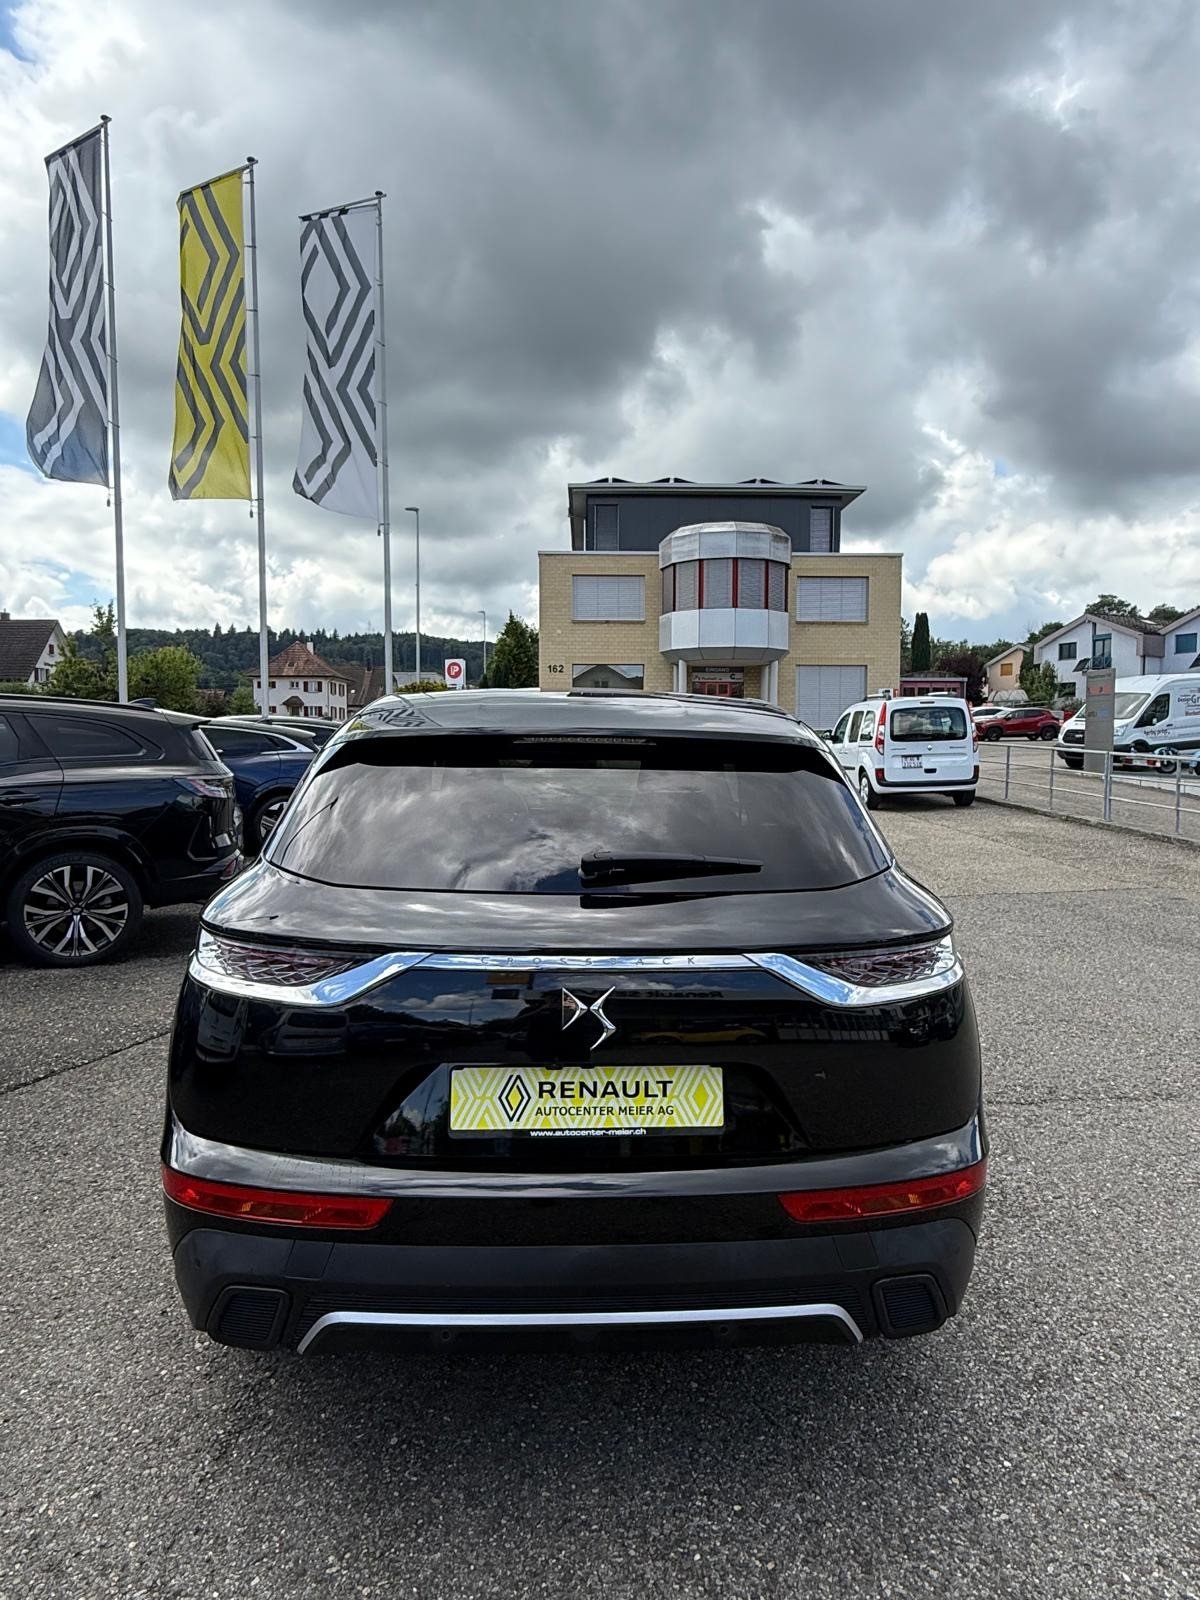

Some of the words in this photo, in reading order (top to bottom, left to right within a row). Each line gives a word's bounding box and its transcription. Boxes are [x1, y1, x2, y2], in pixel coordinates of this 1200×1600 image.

[548, 664, 564, 673] 162
[538, 1080, 673, 1099] RENAULT
[535, 1106, 614, 1117] AUTOCENTER
[618, 1106, 653, 1116] MEIER
[657, 1105, 674, 1116] AG
[530, 1128, 647, 1137] www.autocenter-meier.ch
